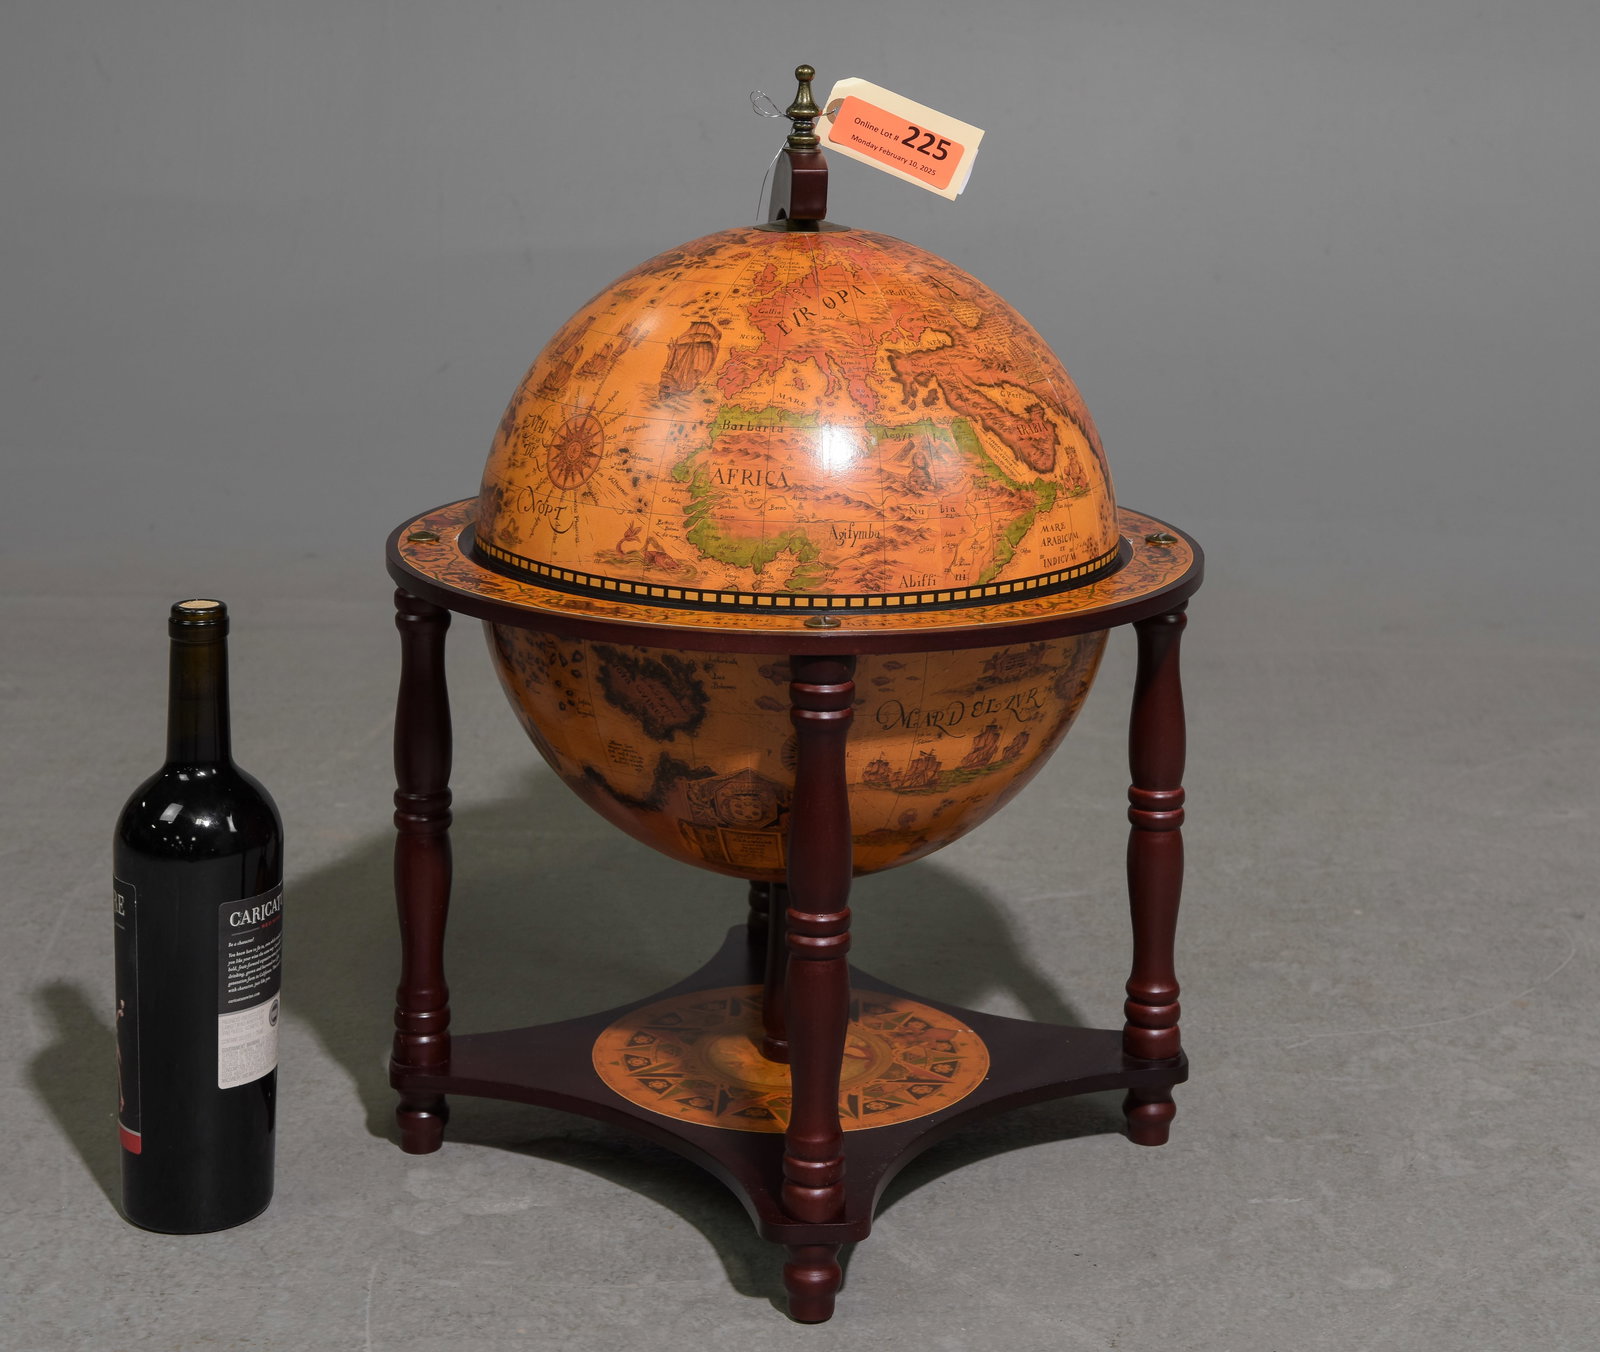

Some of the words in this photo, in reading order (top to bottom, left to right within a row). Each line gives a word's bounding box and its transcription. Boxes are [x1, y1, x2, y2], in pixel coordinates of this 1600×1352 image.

[854, 117, 879, 132] Online
[880, 129, 893, 139] Lot
[901, 126, 952, 161] 225
[850, 134, 878, 151] Monday
[878, 146, 908, 164] February
[909, 159, 918, 169] 10,
[920, 164, 937, 176] 2025
[776, 392, 807, 408] MARE
[722, 420, 784, 433] Barbaria
[1016, 422, 1049, 436] ARABIA
[709, 467, 790, 488] AFRICA
[1040, 522, 1066, 534] MARE
